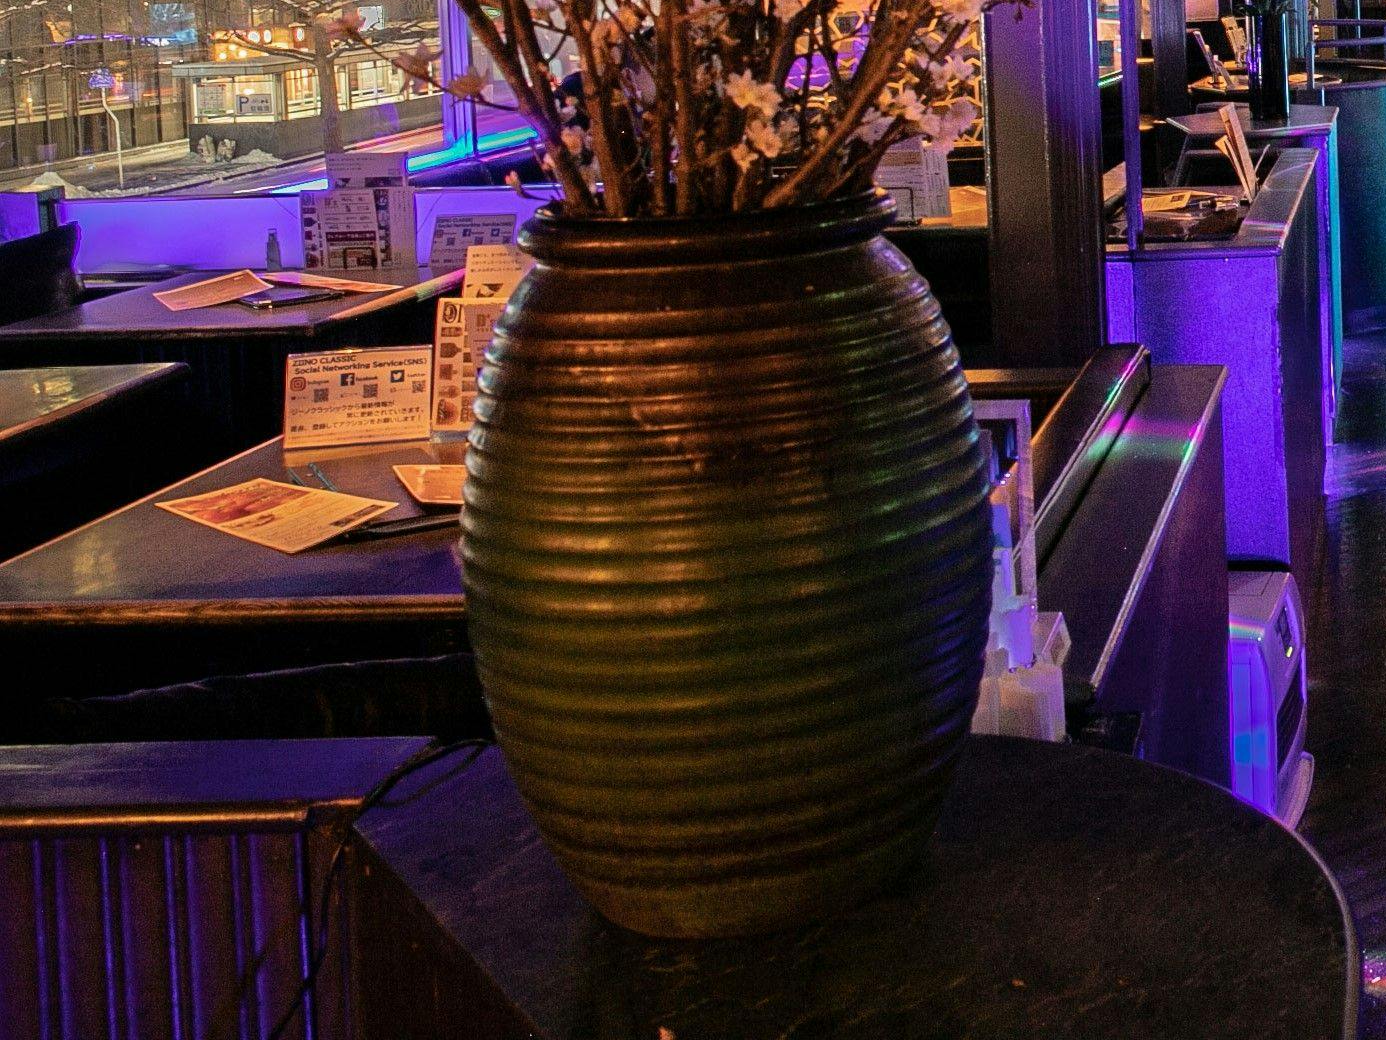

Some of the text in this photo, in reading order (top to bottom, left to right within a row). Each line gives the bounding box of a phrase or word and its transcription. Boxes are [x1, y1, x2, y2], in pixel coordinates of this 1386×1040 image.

[239, 96, 249, 113] P
[294, 357, 427, 375] Social Networking Service(SNS)
[319, 355, 357, 364] CLASSIC
